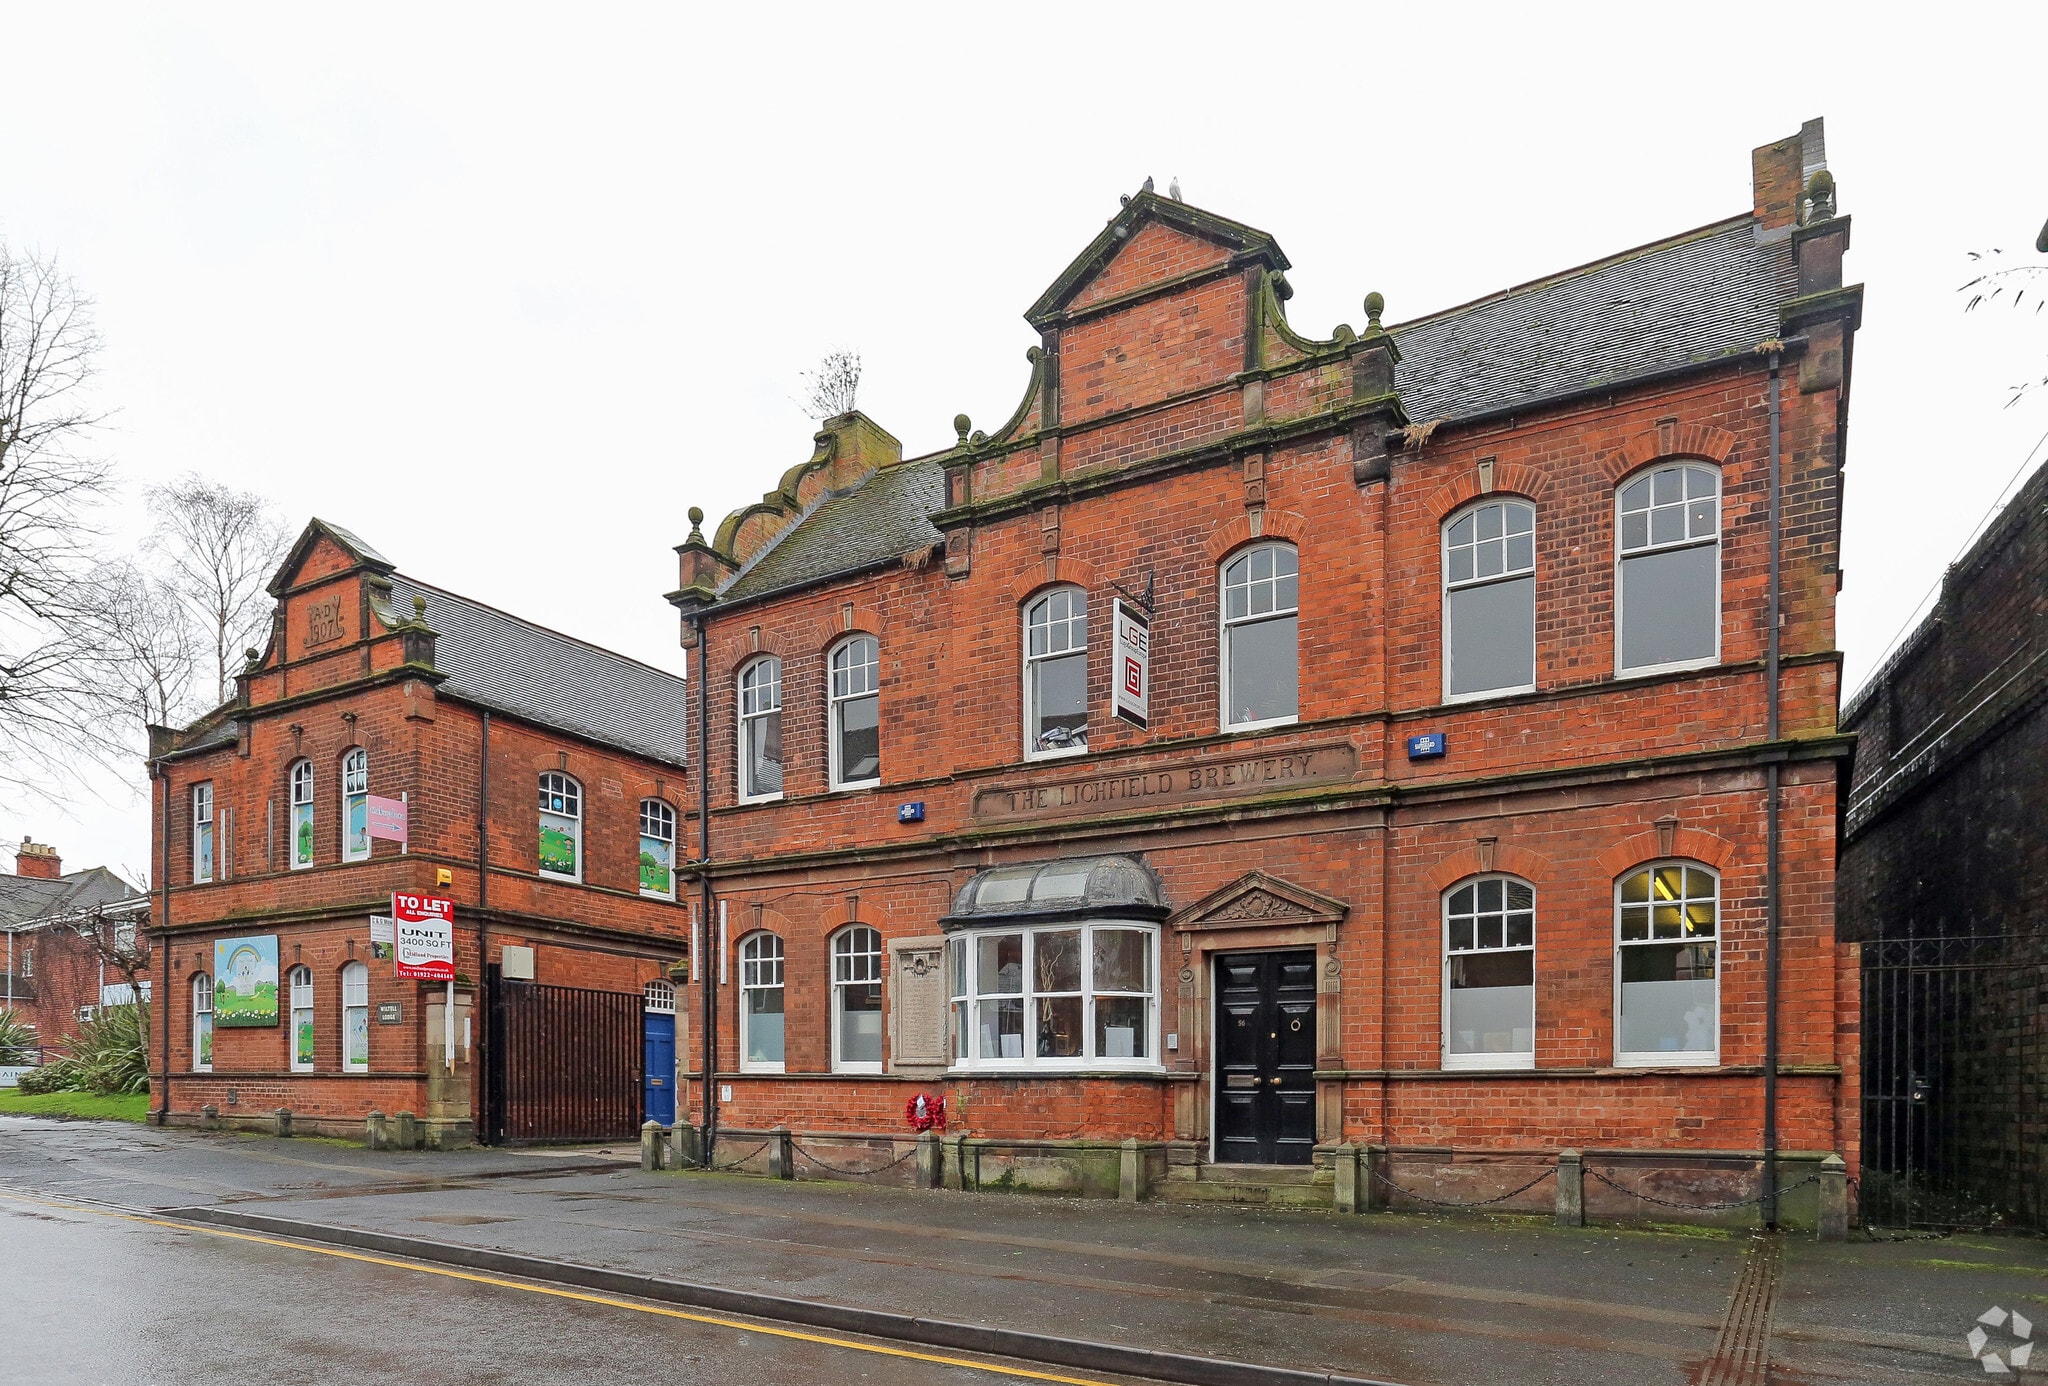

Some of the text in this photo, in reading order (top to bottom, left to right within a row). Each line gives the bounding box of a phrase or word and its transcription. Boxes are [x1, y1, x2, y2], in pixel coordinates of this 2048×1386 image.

[310, 618, 335, 641] 1907
[1120, 620, 1147, 652] LGE
[1007, 754, 1317, 811] THE LICHFIELD BREWERY.
[398, 895, 451, 913] TO LET
[400, 937, 452, 949] 3400 SQ FT
[401, 928, 448, 939] UNIT
